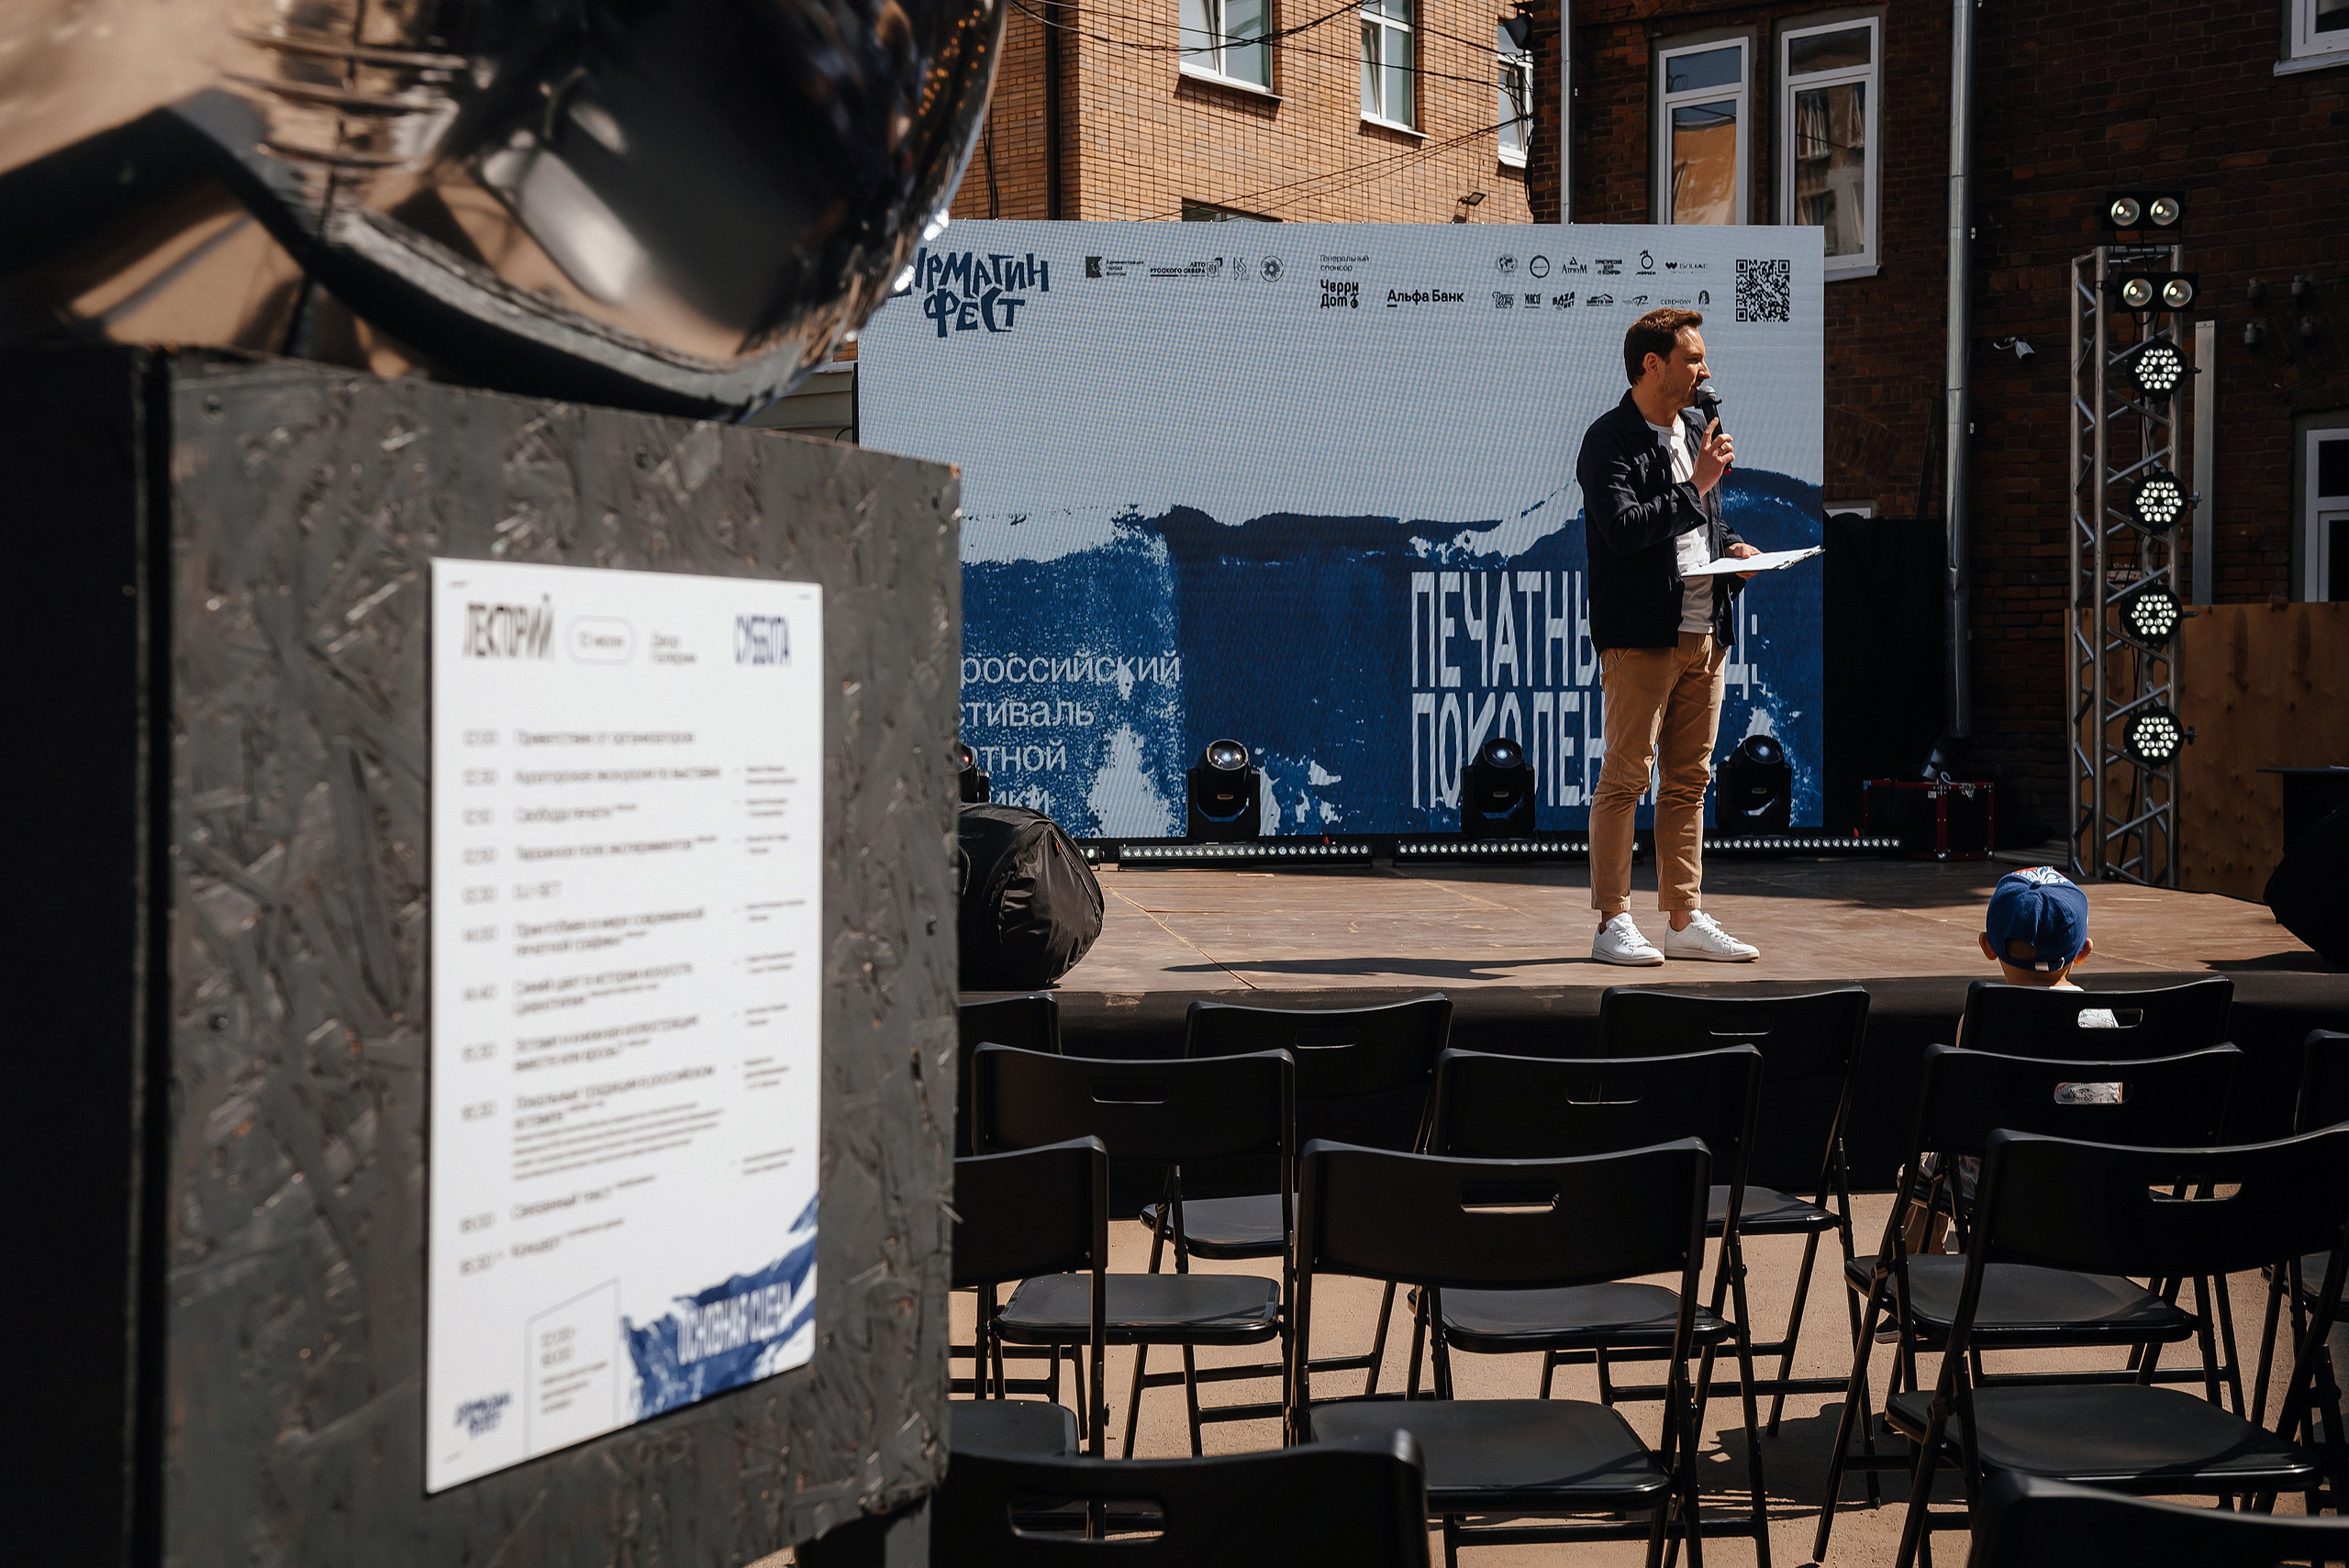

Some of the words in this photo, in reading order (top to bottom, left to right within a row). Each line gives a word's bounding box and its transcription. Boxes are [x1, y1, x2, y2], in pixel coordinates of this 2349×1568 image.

[1319, 264, 1353, 272] спонсор
[1319, 278, 1360, 296] Черри
[1319, 293, 1348, 309] Дом
[1386, 288, 1430, 307] Альфа
[1431, 288, 1465, 303] Банк
[923, 286, 1026, 338] ФЕСТ
